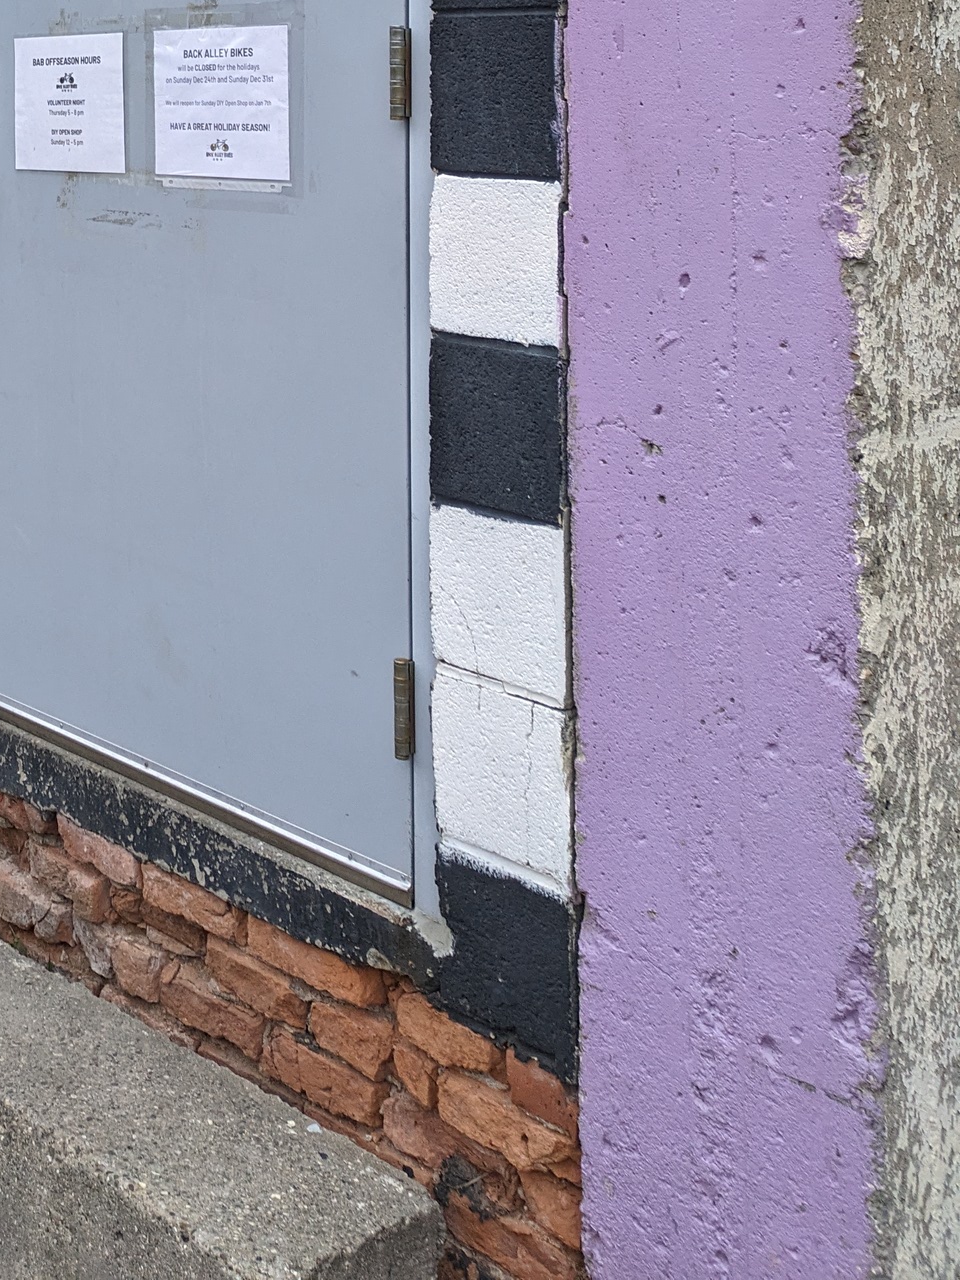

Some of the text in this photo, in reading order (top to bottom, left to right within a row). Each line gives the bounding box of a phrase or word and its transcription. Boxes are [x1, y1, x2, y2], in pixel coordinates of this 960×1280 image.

[183, 48, 253, 58] BACK ALLEY BIKES
[33, 56, 101, 66] BAB OFFSEASON HOURS
[237, 64, 260, 72] holidays
[173, 76, 192, 85] Sunday
[229, 75, 249, 84] Sunday
[214, 123, 240, 131] HOLIDAY
[242, 123, 270, 132] SEASON!
